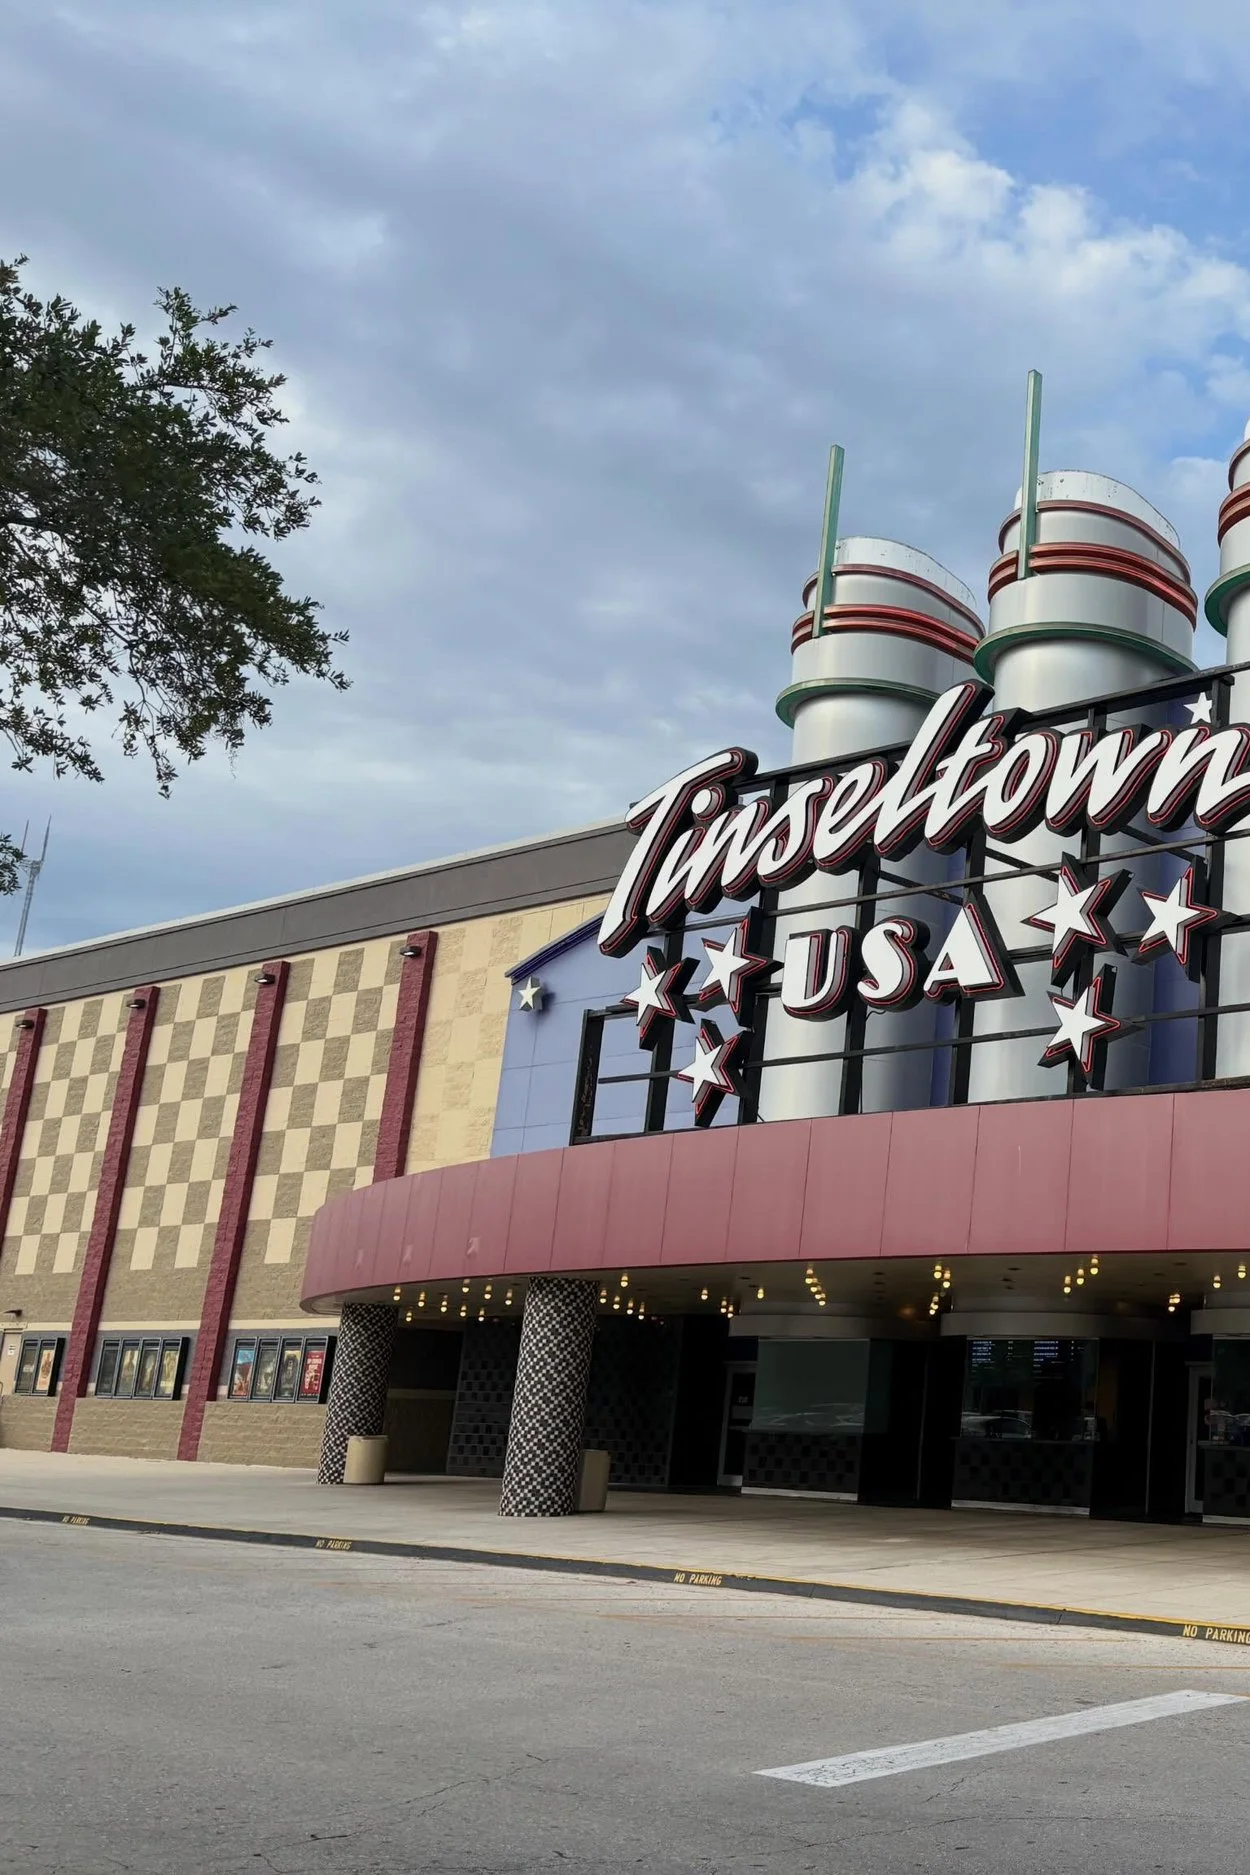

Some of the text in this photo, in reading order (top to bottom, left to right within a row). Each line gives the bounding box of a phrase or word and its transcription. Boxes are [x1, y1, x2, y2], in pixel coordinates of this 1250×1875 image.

[780, 897, 1014, 1019] USA
[673, 1572, 723, 1586] NO PARKING
[1182, 1624, 1198, 1638] NO
